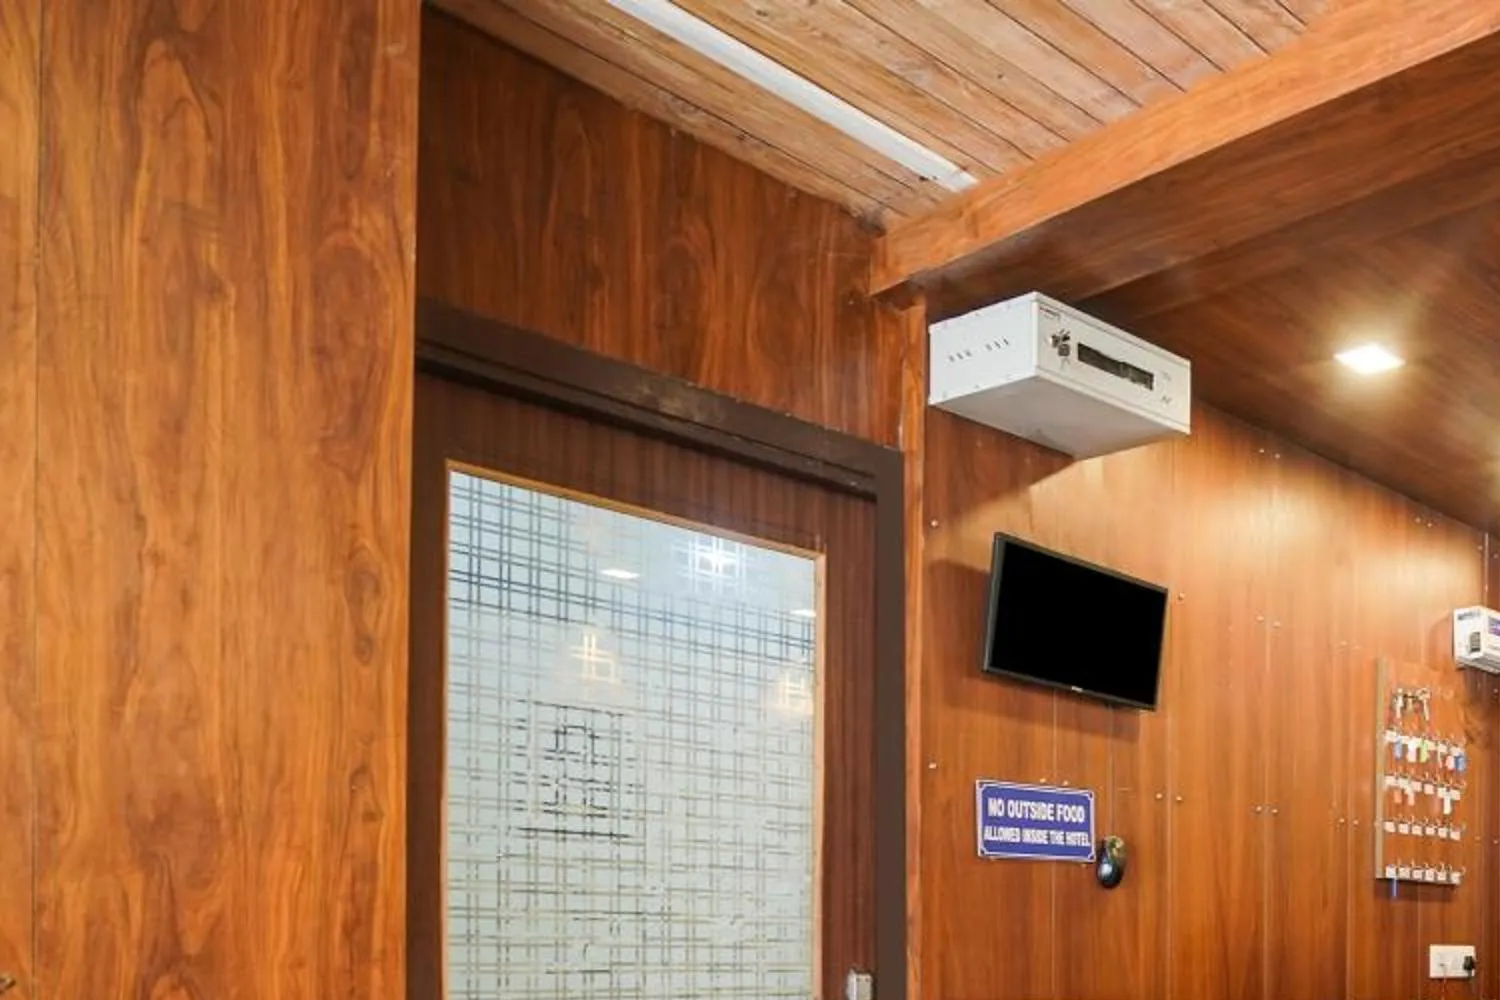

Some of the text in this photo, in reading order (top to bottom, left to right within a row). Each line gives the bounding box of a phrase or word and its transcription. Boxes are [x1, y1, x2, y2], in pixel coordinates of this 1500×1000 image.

[988, 797, 1086, 823] NO OUTSIDE FOOD
[983, 825, 1091, 847] ALLOWED INSIDE THE HOTEL
